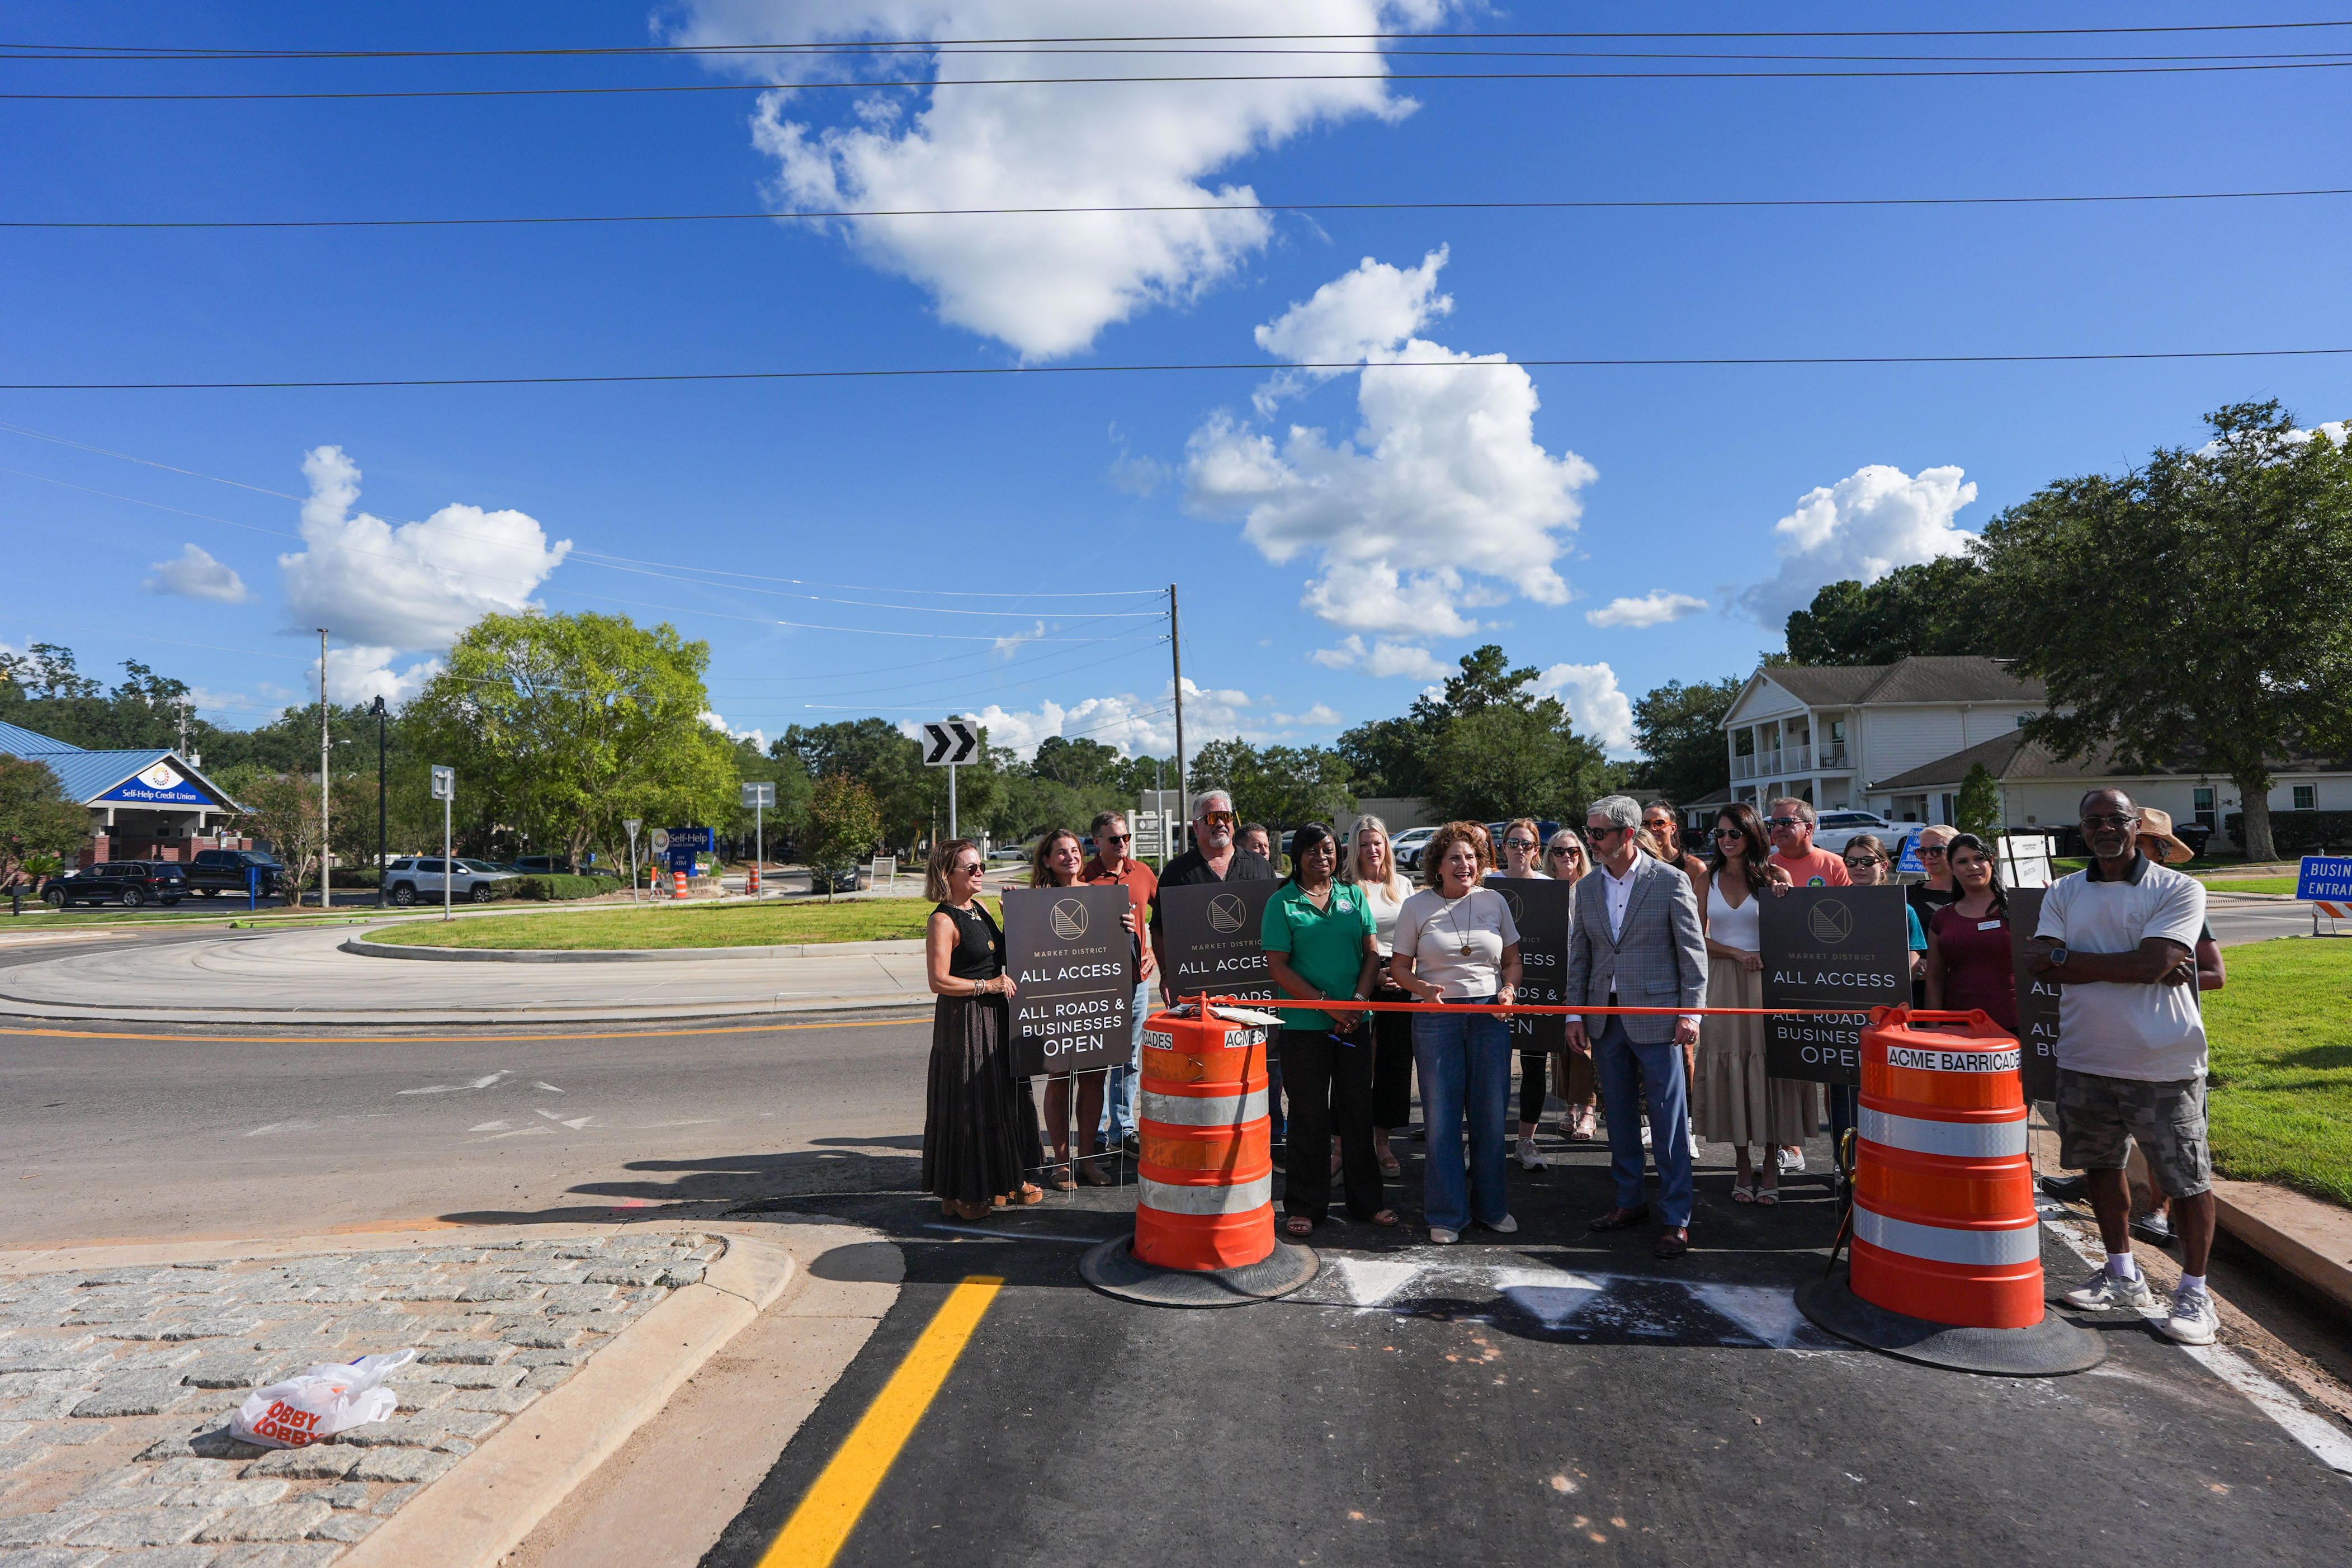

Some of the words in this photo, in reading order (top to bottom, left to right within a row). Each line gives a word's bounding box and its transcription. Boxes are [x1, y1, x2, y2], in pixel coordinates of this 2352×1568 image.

[122, 789, 154, 800] Self-Help
[155, 791, 175, 799] Credit
[670, 833, 707, 844] Self-Help
[2311, 863, 2352, 877] BUSIN
[1035, 950, 1068, 958] MARKET
[1072, 947, 1107, 955] DISTRICT
[1192, 942, 1226, 951] MARKET
[1519, 953, 1555, 966] ESS
[1020, 969, 1051, 983] ALL
[1057, 963, 1121, 980] ACCESS
[1178, 961, 1210, 975] ALL
[1773, 970, 1807, 984] ALL
[1815, 972, 1895, 988] ACCESS
[1547, 989, 1558, 1000] &
[2030, 981, 2058, 996] AL
[1018, 1006, 1049, 1020] ALL
[1056, 1000, 1109, 1017] ROADS
[1115, 998, 1125, 1010] &
[1023, 1016, 1122, 1037] BUSINESSES
[1773, 1013, 1805, 1022] ALL
[1813, 1013, 1879, 1026] ROAD
[1777, 1027, 1859, 1044] BUSINES
[2030, 1023, 2058, 1038] AL
[1043, 1034, 1103, 1056] OPEN
[1142, 1030, 1172, 1049] CADES
[1226, 1030, 1256, 1047] ACME
[1801, 1046, 1861, 1067] OPE
[1888, 1049, 1935, 1069] ACME
